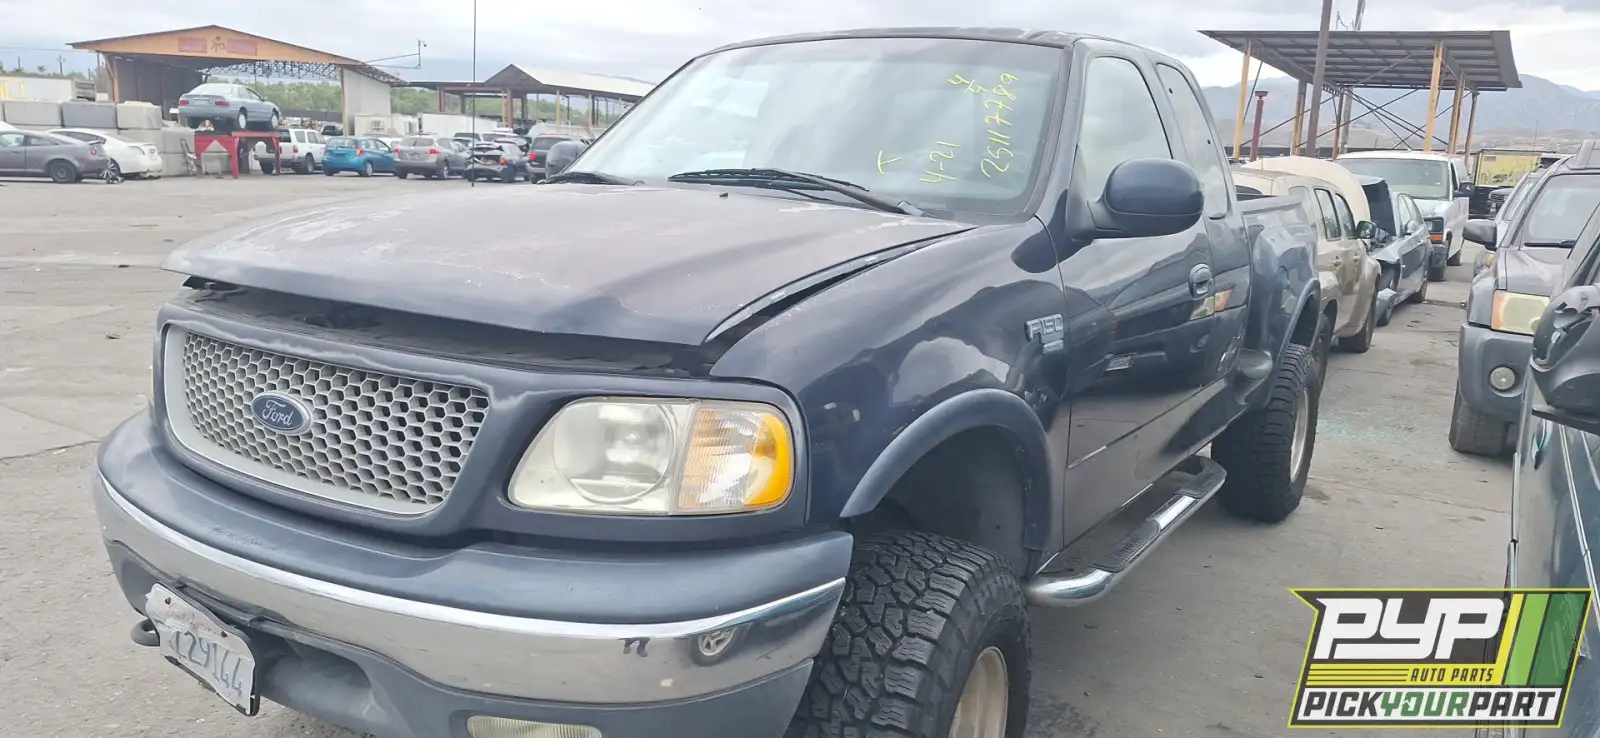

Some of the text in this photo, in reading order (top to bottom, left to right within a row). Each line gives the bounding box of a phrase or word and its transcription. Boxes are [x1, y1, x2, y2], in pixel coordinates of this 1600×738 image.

[876, 150, 902, 175] T
[918, 140, 961, 183] 4-21
[262, 399, 294, 426] Ford
